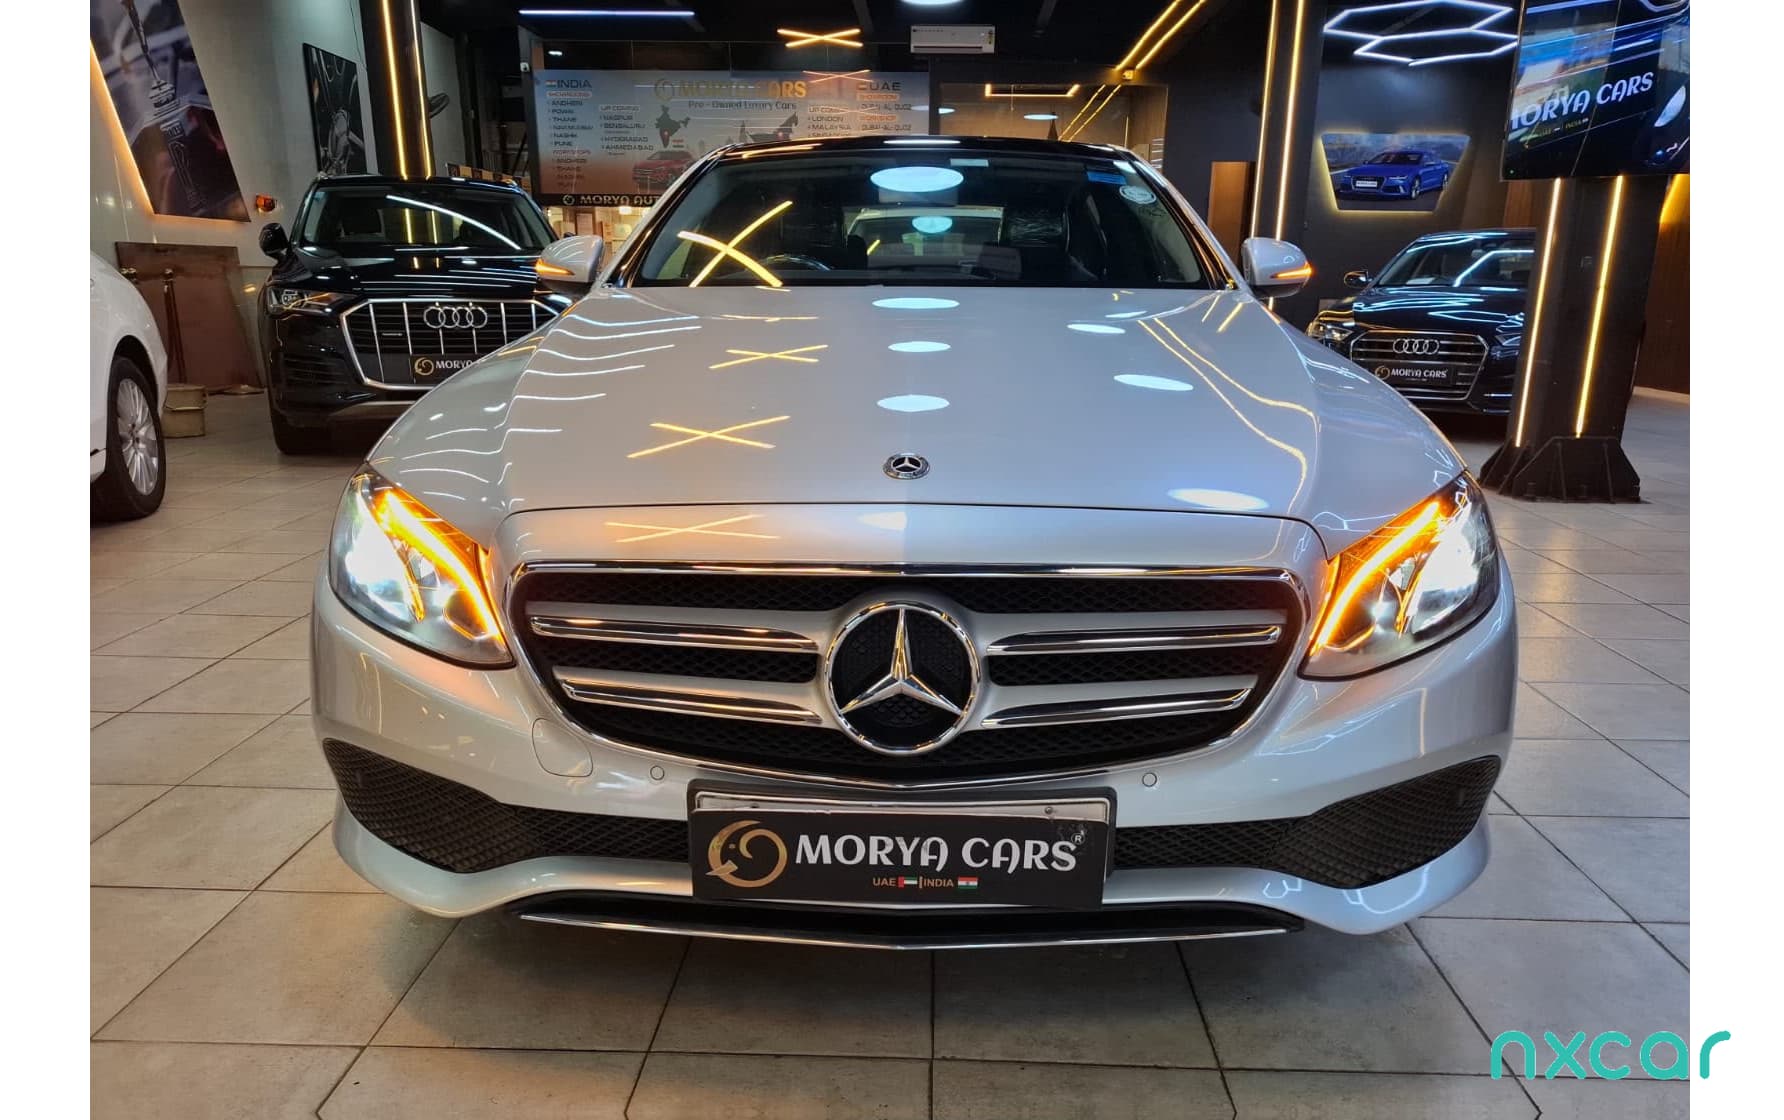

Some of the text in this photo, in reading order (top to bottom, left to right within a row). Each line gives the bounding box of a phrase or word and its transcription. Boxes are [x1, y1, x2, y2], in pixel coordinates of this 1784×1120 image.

[557, 79, 592, 89] INDIA
[869, 82, 901, 91] UAE
[1596, 71, 1654, 105] CARS
[775, 101, 797, 109] Cars
[580, 194, 630, 206] MORYA
[1391, 367, 1447, 378] MORYA CARS
[795, 833, 949, 872] MORYA
[961, 837, 1077, 874] CARS
[872, 876, 954, 889] UAE INDIA
